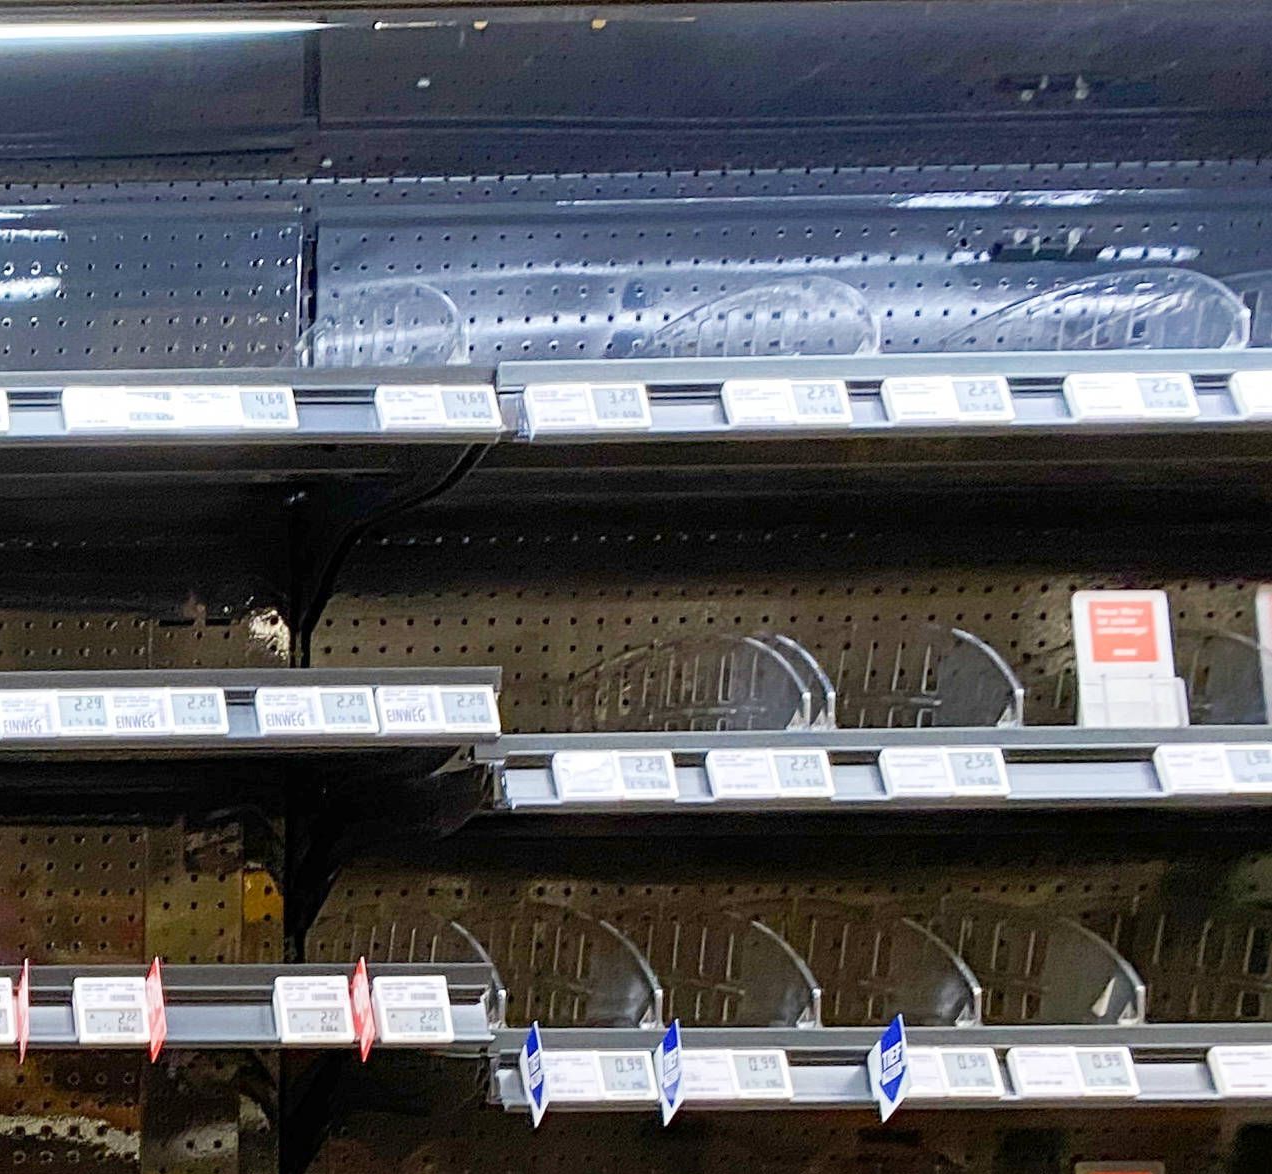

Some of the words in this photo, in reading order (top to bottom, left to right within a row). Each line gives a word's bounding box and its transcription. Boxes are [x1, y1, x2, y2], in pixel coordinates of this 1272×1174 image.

[116, 713, 155, 729] EINWEG
[266, 712, 305, 727] EINWEG
[386, 708, 425, 723] EINWEG
